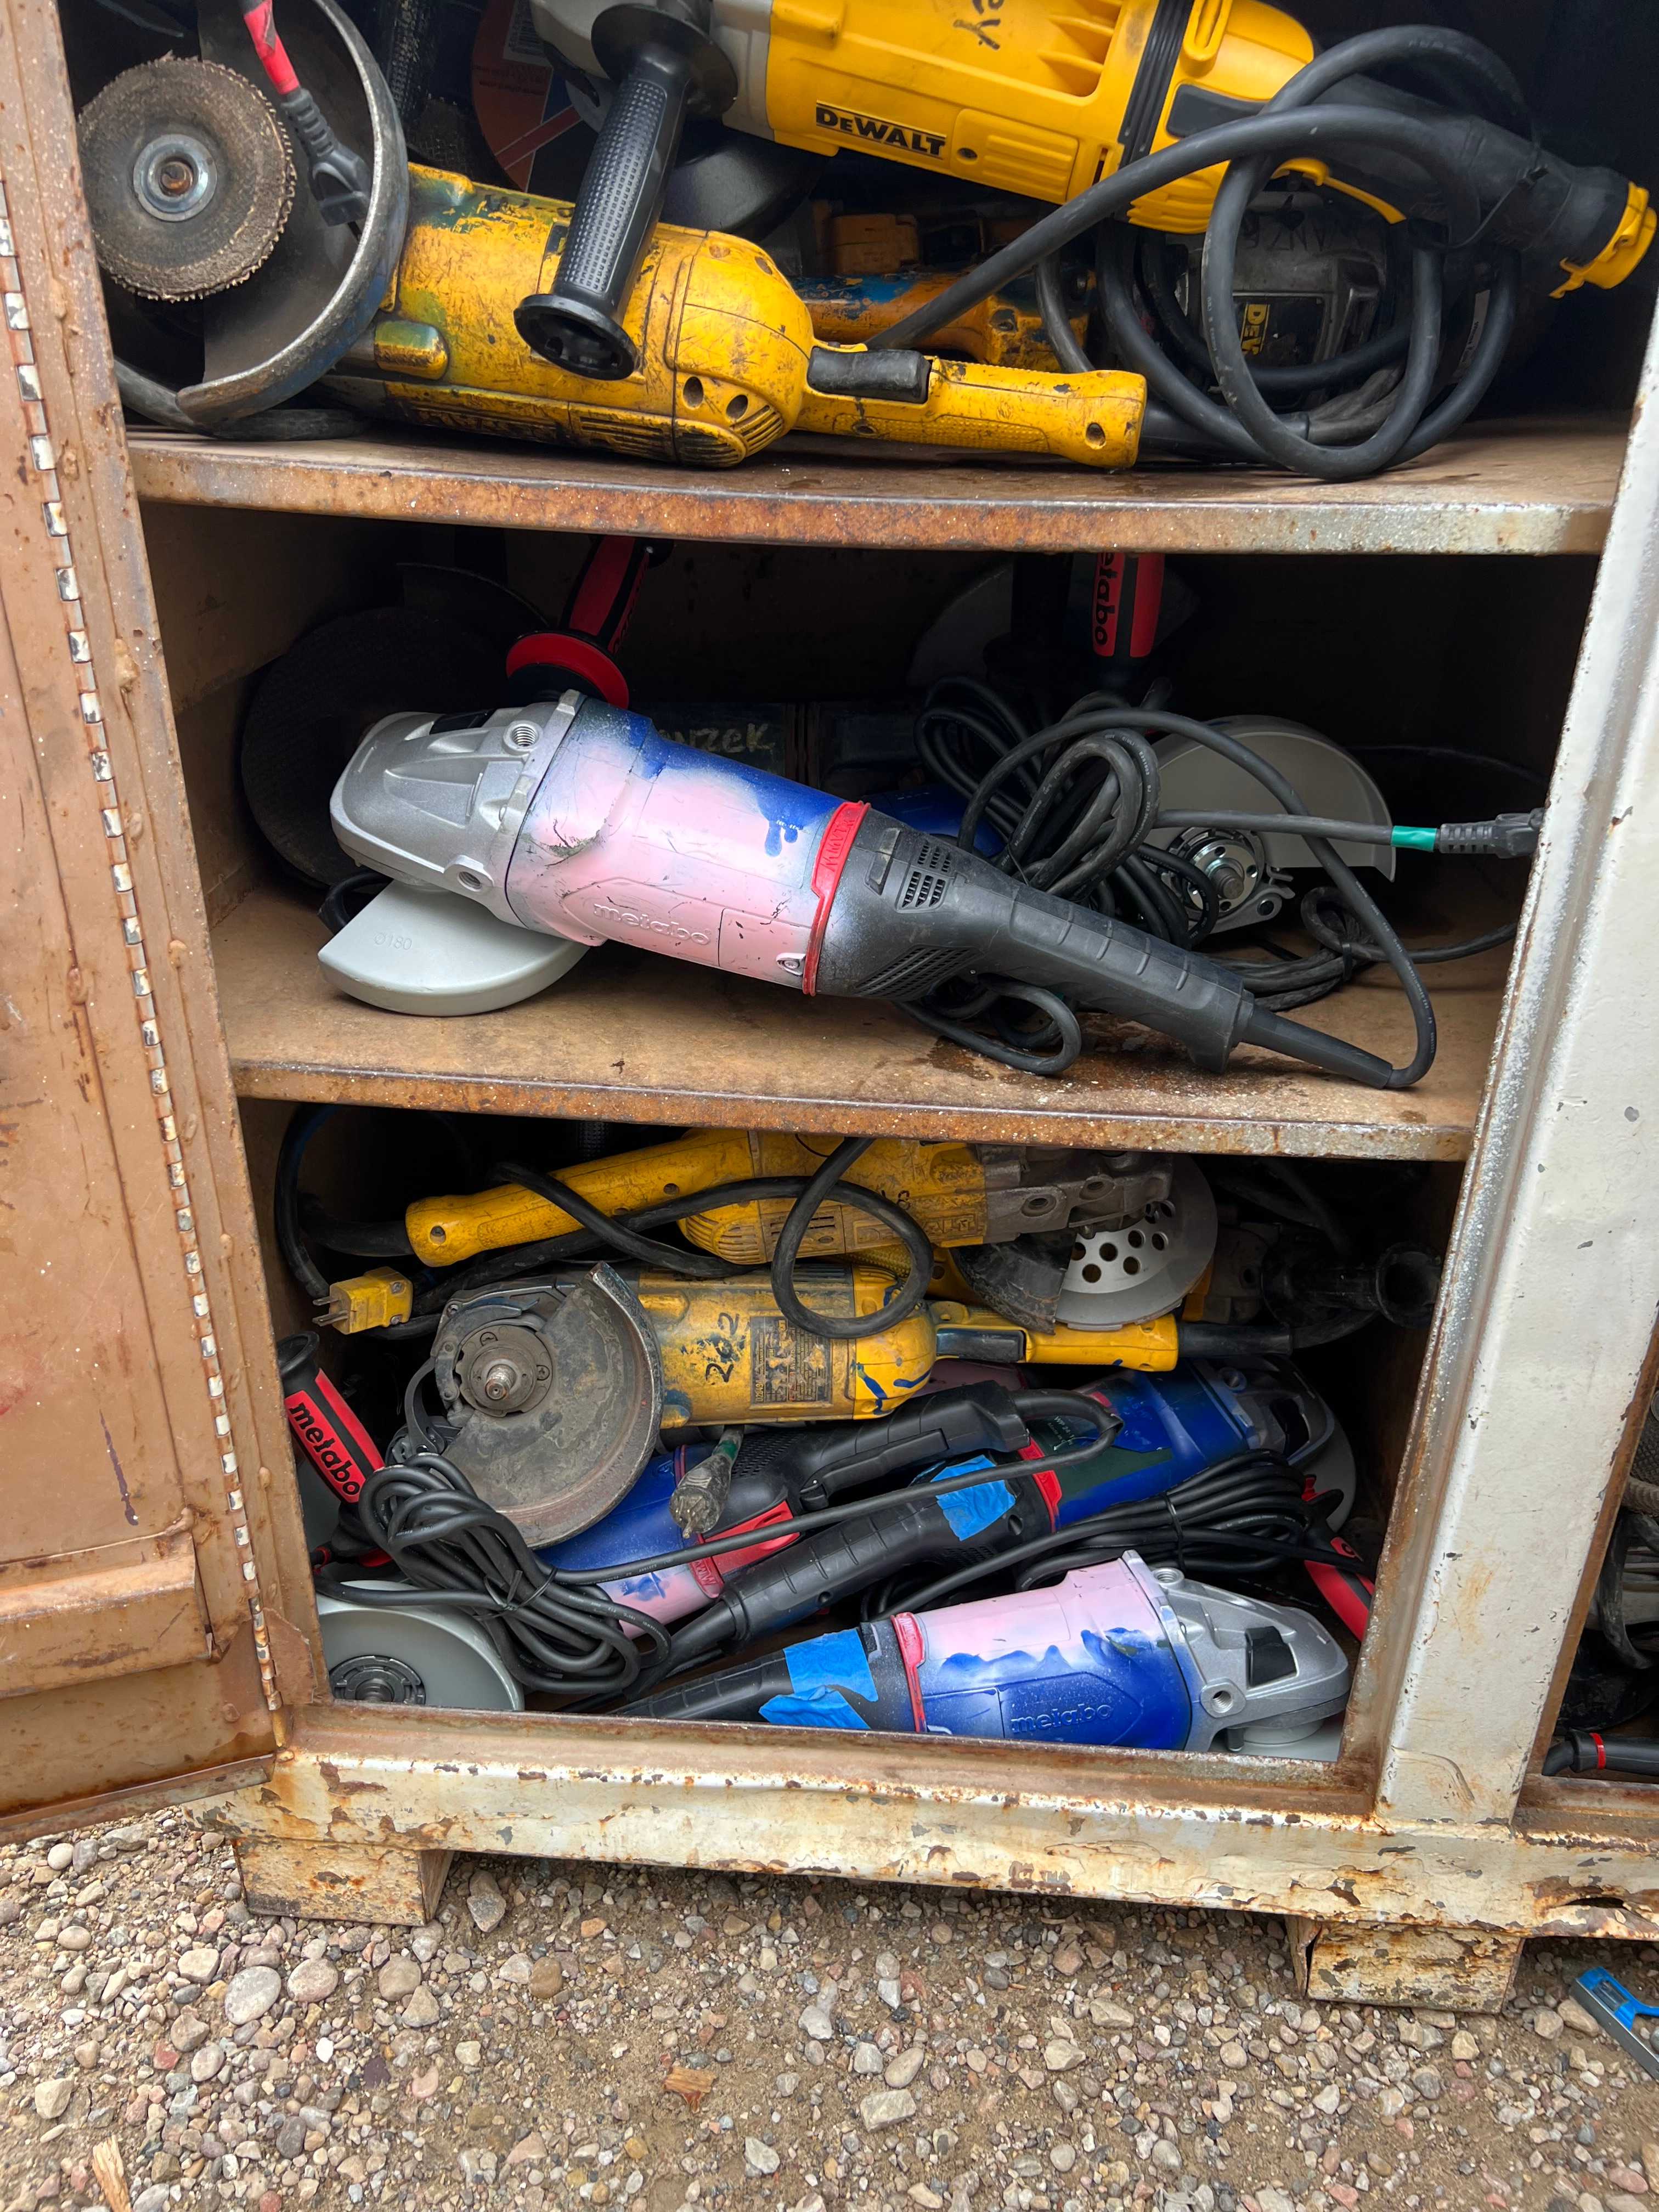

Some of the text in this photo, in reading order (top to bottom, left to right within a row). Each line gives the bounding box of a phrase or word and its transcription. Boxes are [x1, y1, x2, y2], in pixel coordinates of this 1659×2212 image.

[816, 106, 946, 156] DEWALT
[1095, 552, 1118, 645] etabo
[594, 904, 711, 945] metabo
[289, 1403, 360, 1495] metabo
[1011, 1703, 1112, 1733] metabo
